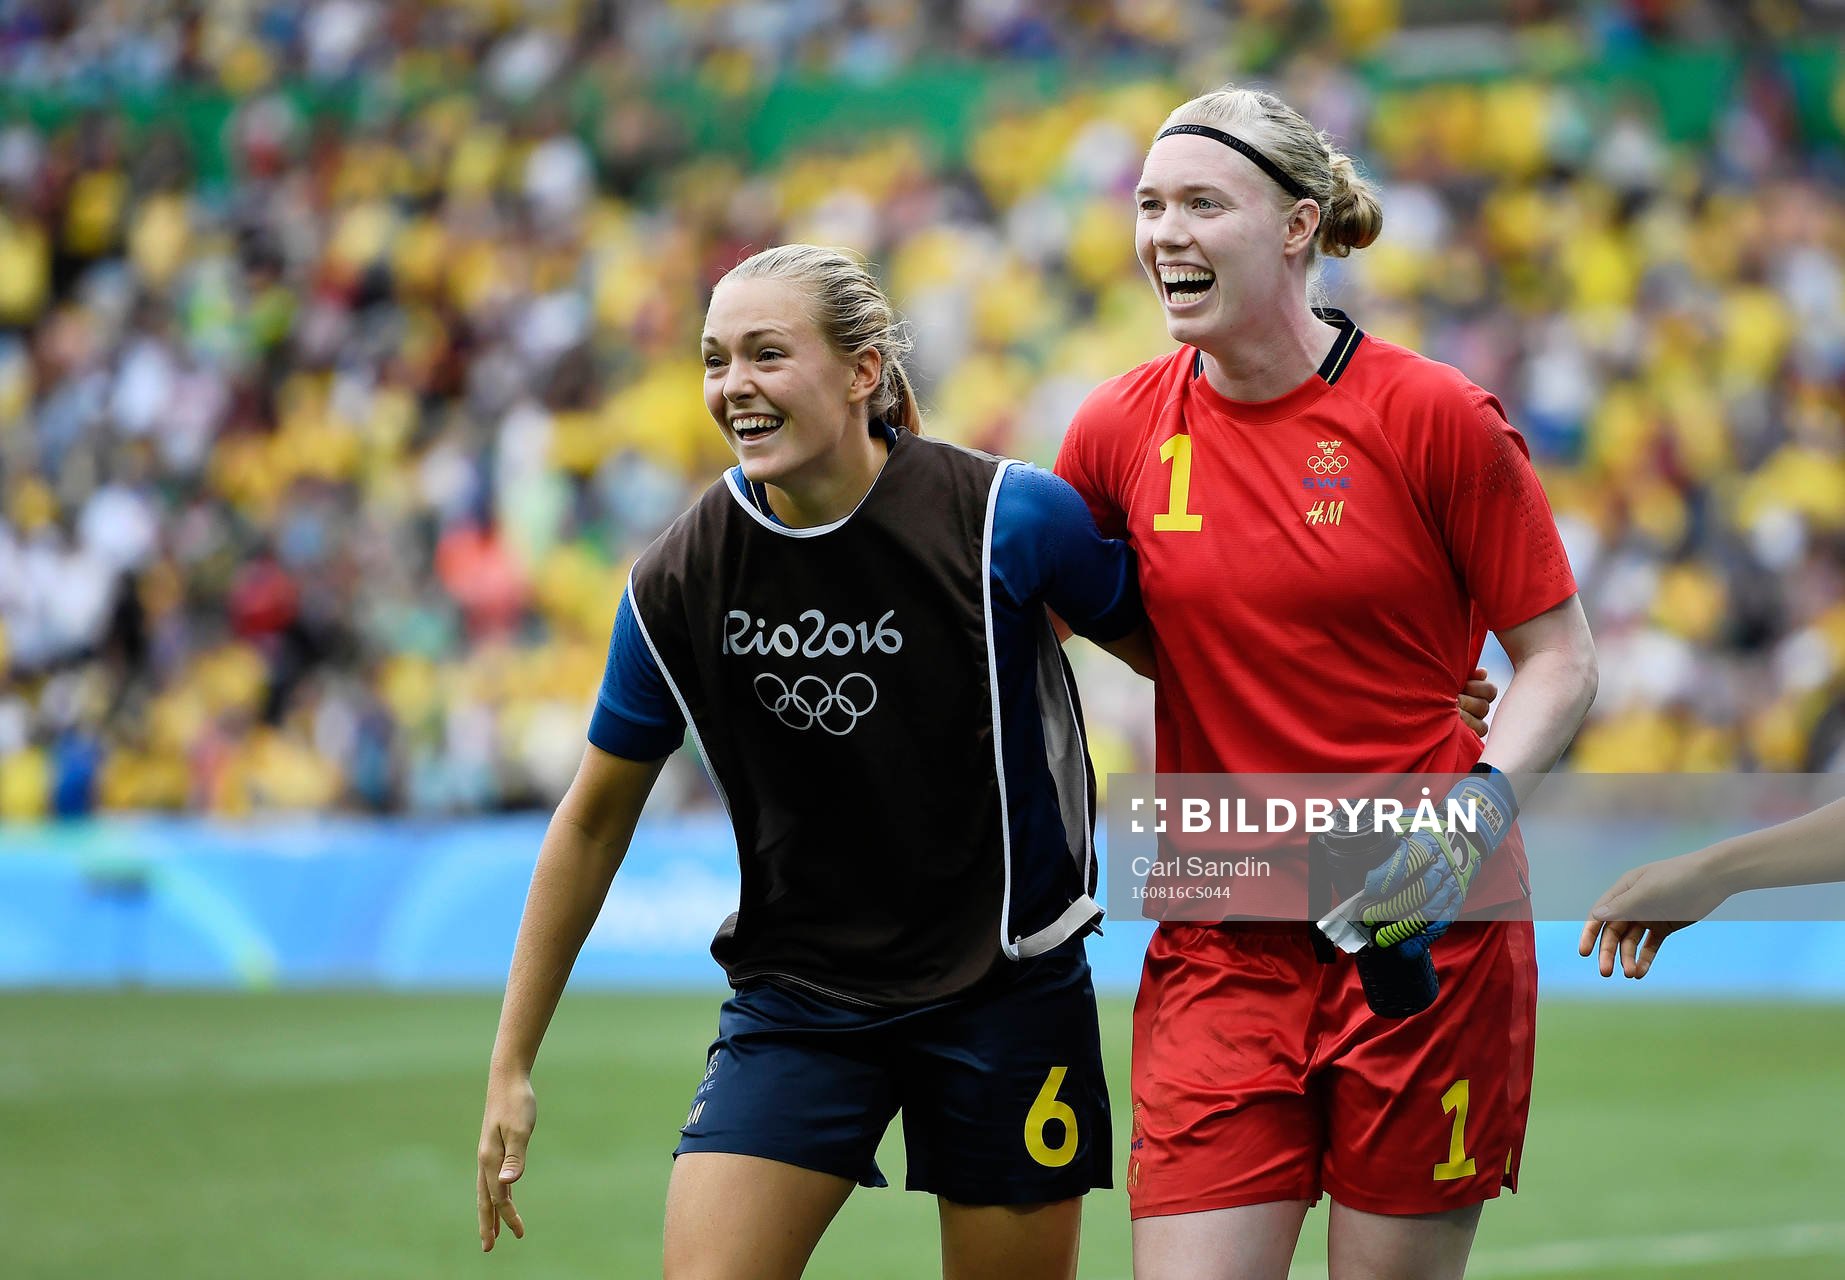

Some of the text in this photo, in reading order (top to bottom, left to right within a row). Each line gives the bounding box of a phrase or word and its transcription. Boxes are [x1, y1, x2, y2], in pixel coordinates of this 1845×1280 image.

[1153, 434, 1203, 532] 1
[1302, 477, 1352, 490] SWE
[1305, 500, 1345, 527] H&M
[1024, 1066, 1079, 1168] 6
[1433, 1079, 1477, 1181] 1
